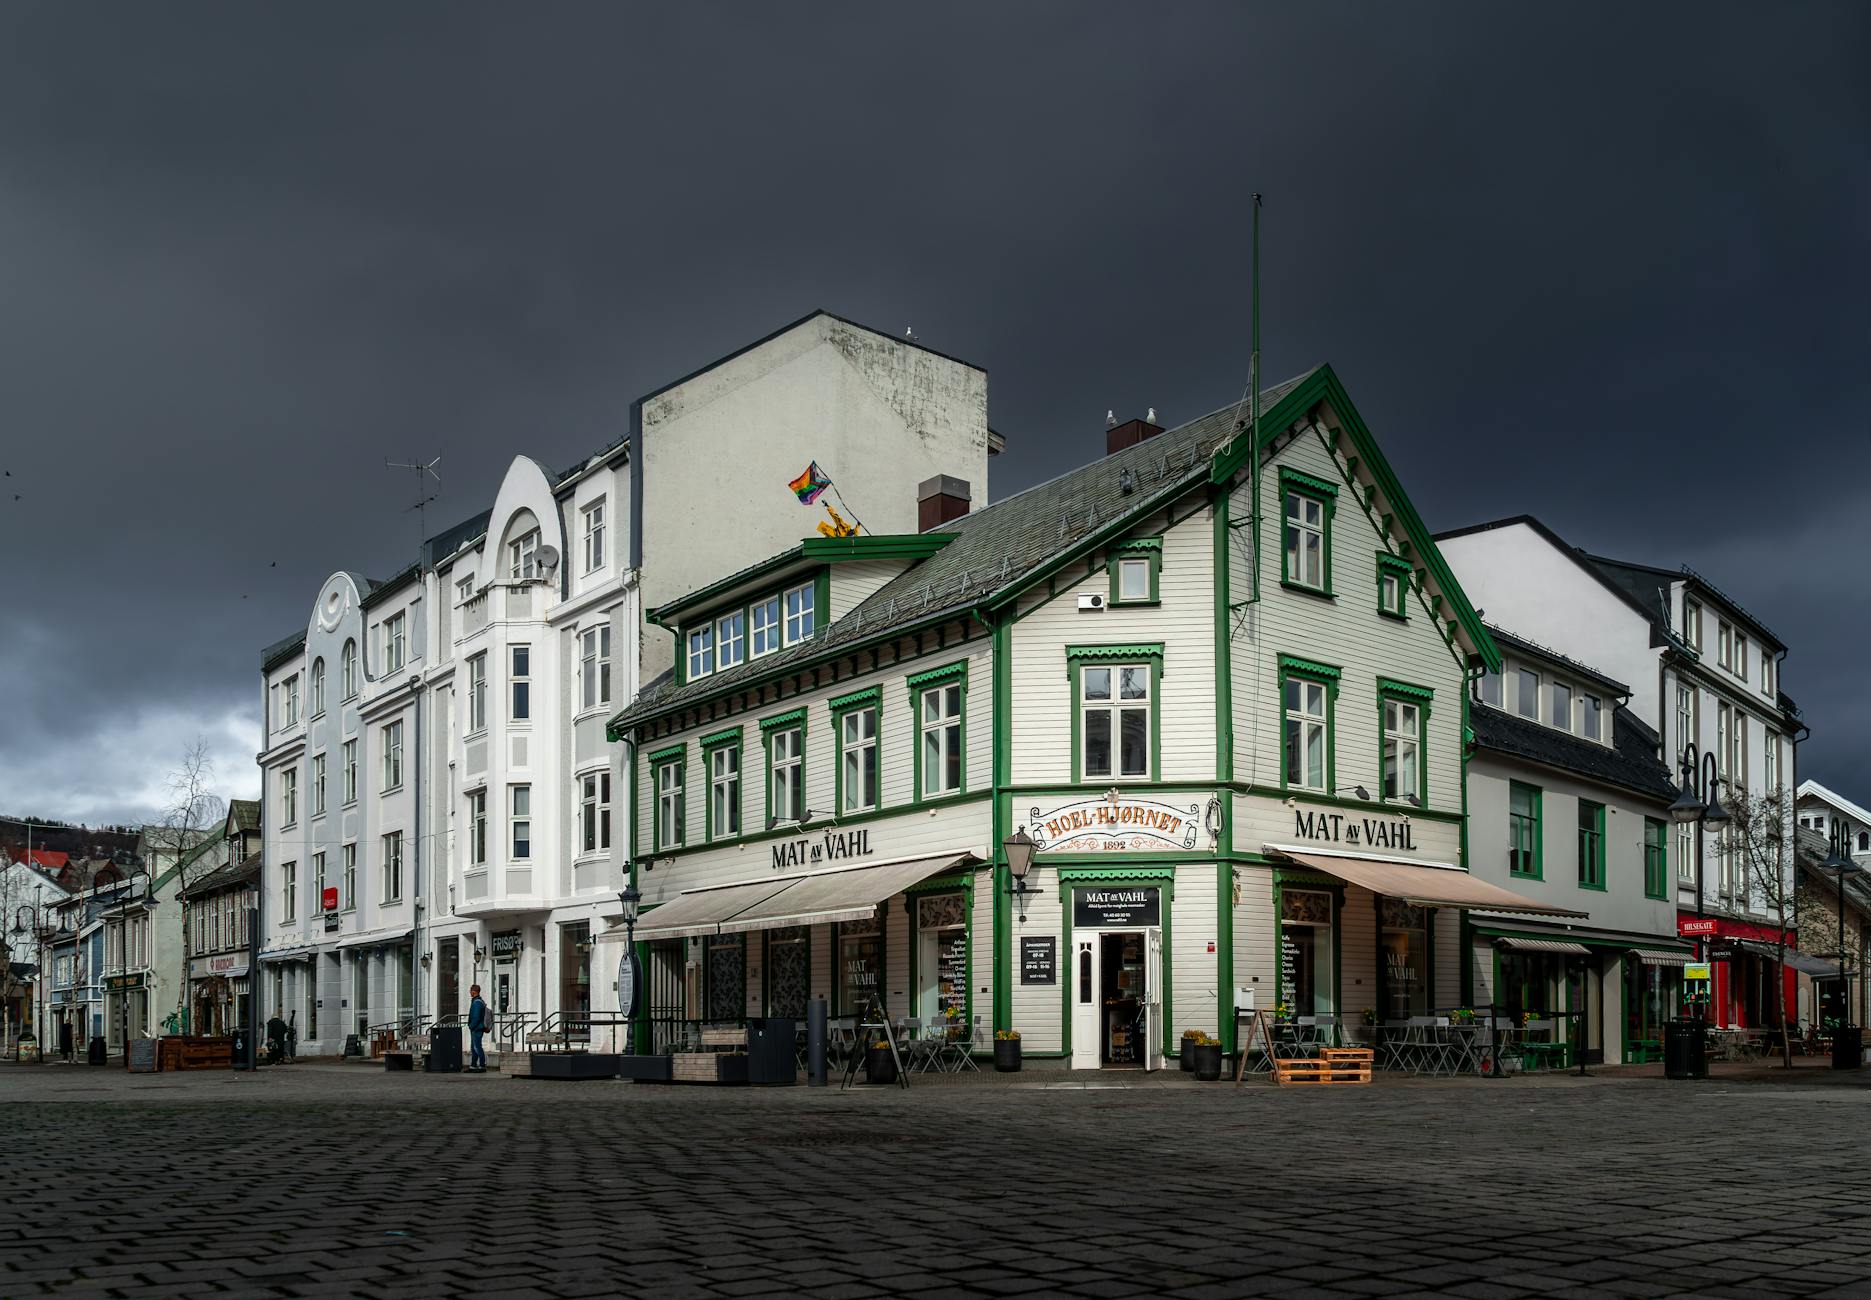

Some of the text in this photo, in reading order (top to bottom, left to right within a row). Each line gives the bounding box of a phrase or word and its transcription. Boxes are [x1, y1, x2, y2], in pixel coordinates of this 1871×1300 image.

[1045, 805, 1182, 839] HOEL-HJØRNET
[1295, 810, 1417, 850] MAT AV VAHL
[772, 829, 873, 869] MAT AV VAHL
[1103, 841, 1126, 850] 1892
[1086, 892, 1110, 902] MAT
[1118, 892, 1147, 902] VAHL
[848, 960, 866, 972] MAT
[855, 973, 878, 985] VAHL
